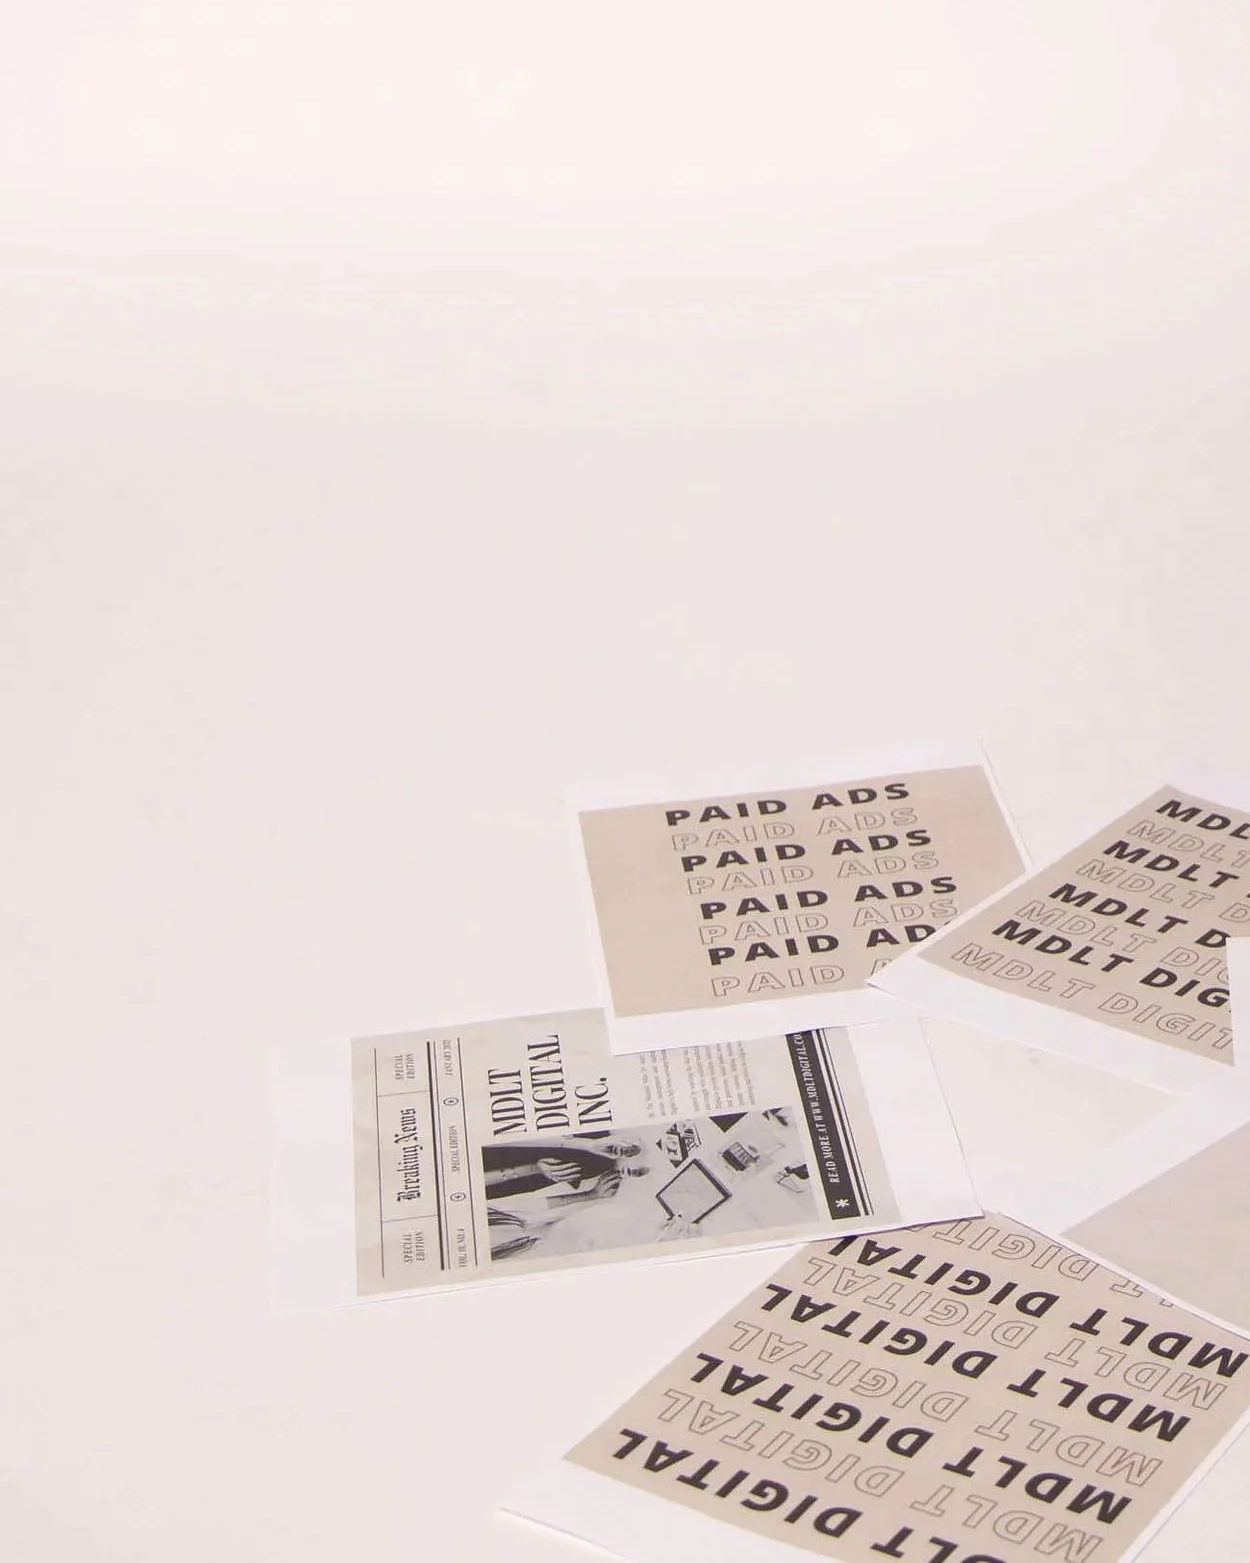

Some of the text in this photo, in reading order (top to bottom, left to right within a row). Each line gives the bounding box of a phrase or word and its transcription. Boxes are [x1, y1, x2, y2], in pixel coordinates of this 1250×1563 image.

[665, 783, 909, 826] PAID ADS
[672, 807, 918, 851] PAID ADS
[681, 829, 931, 872] PAID ADS
[687, 851, 939, 895] PAID ADS
[1102, 840, 1240, 888] MDLT
[700, 876, 957, 920] PAID ADS
[1049, 882, 1189, 934] MDLT
[1075, 859, 1216, 909] MDLT
[698, 899, 961, 945] PAID ADS
[708, 921, 950, 966] PAID AD
[991, 919, 1135, 973] MDLT
[1014, 899, 1157, 953] MDLT
[711, 965, 845, 997] PAID
[951, 942, 1096, 999] MDLT
[1098, 992, 1234, 1050] DIGIT
[488, 1068, 527, 1136] MDLT
[527, 1034, 570, 1131] DIGITAL
[575, 1077, 612, 1124] INC.
[793, 1034, 840, 1183] READ MORE AT WWW.MDLTDIGITAL.CO
[394, 1107, 423, 1202] Breaking News
[403, 1233, 413, 1263] SPECIAL
[415, 1231, 425, 1261] EDITION
[904, 1218, 1099, 1282] DIGIT
[803, 1256, 1228, 1411] MDLT DIGITAL
[828, 1235, 1250, 1378] MDLT DIGITAL
[760, 1283, 1191, 1442] MDLT DIGITAL
[728, 1320, 1164, 1487] MDLT DIGITAL
[689, 1352, 1132, 1524] MDLT DIGITAL
[612, 1428, 864, 1539] DIGITAL
[657, 1388, 1104, 1563] MDLT DIGITAL
